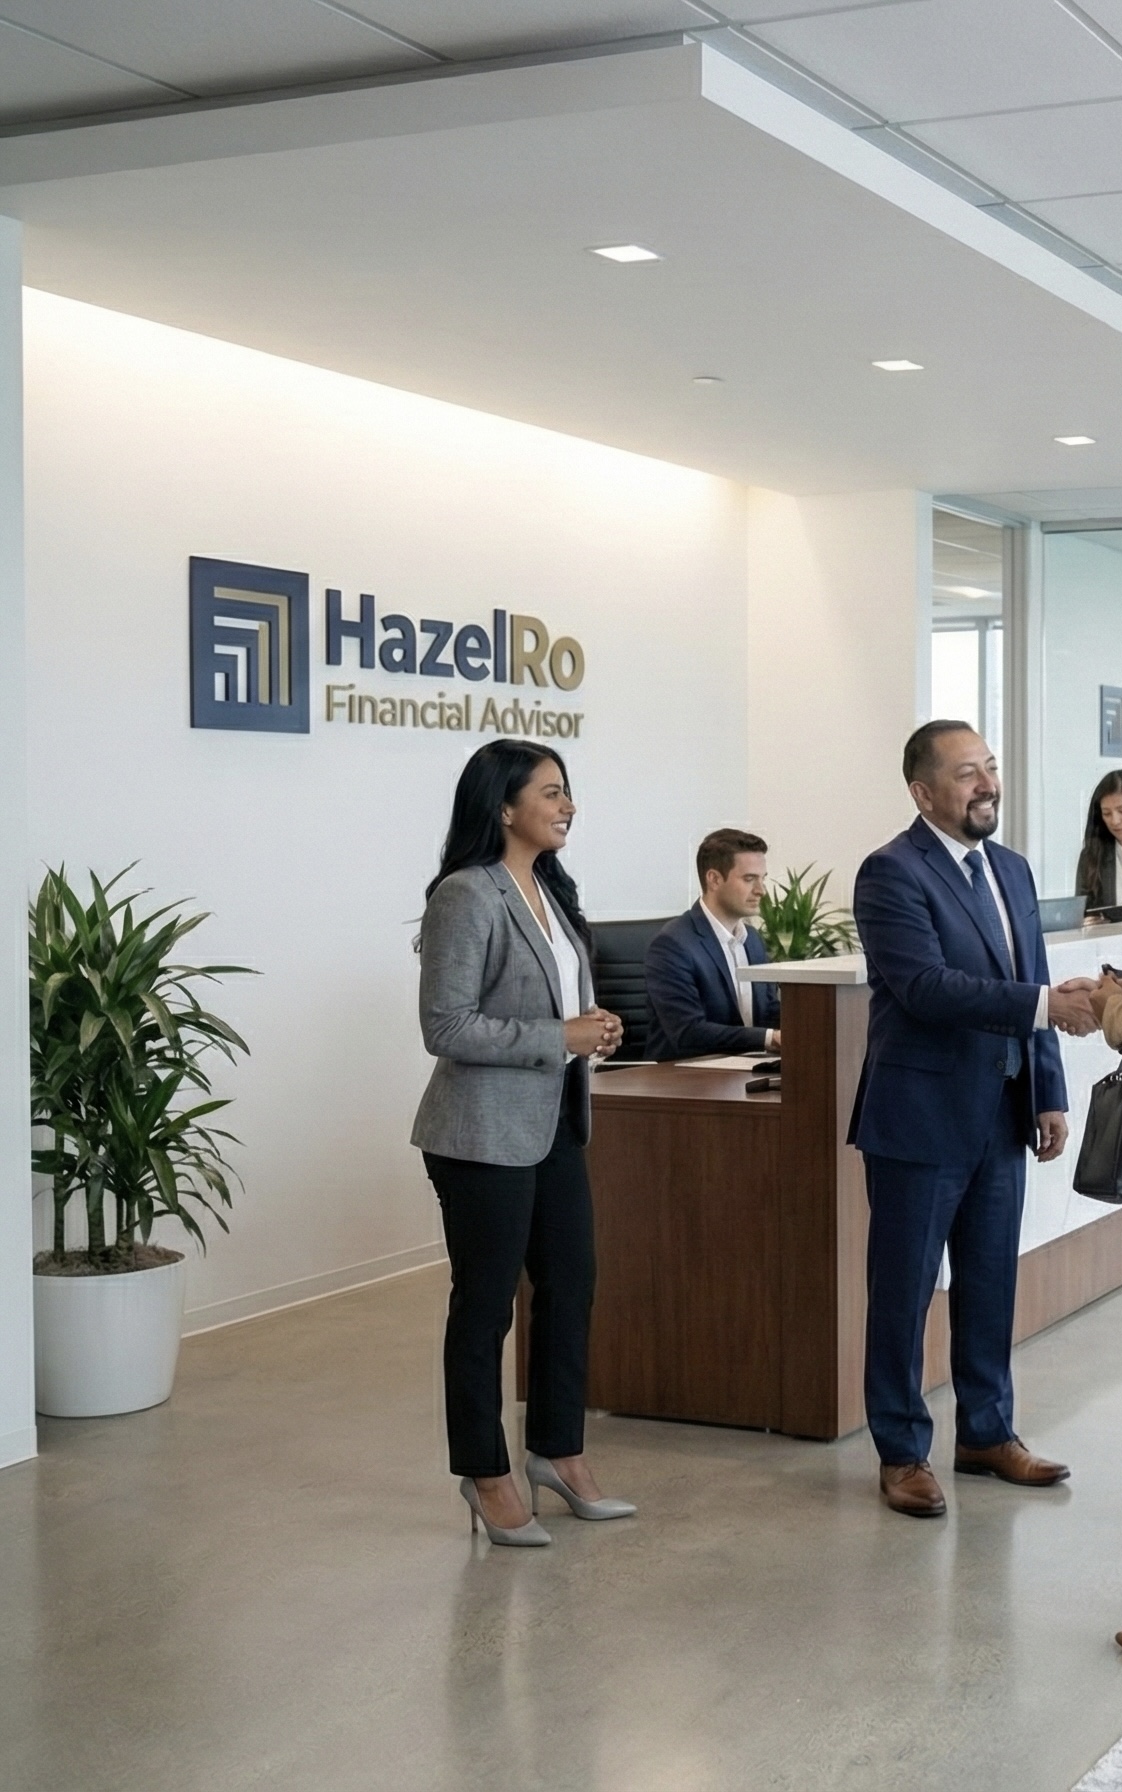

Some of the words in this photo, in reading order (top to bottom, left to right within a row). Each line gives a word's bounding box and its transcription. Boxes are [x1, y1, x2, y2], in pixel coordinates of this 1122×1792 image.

[325, 588, 586, 692] HazelRo
[325, 683, 472, 731] Financial
[480, 697, 585, 739] Advisor
